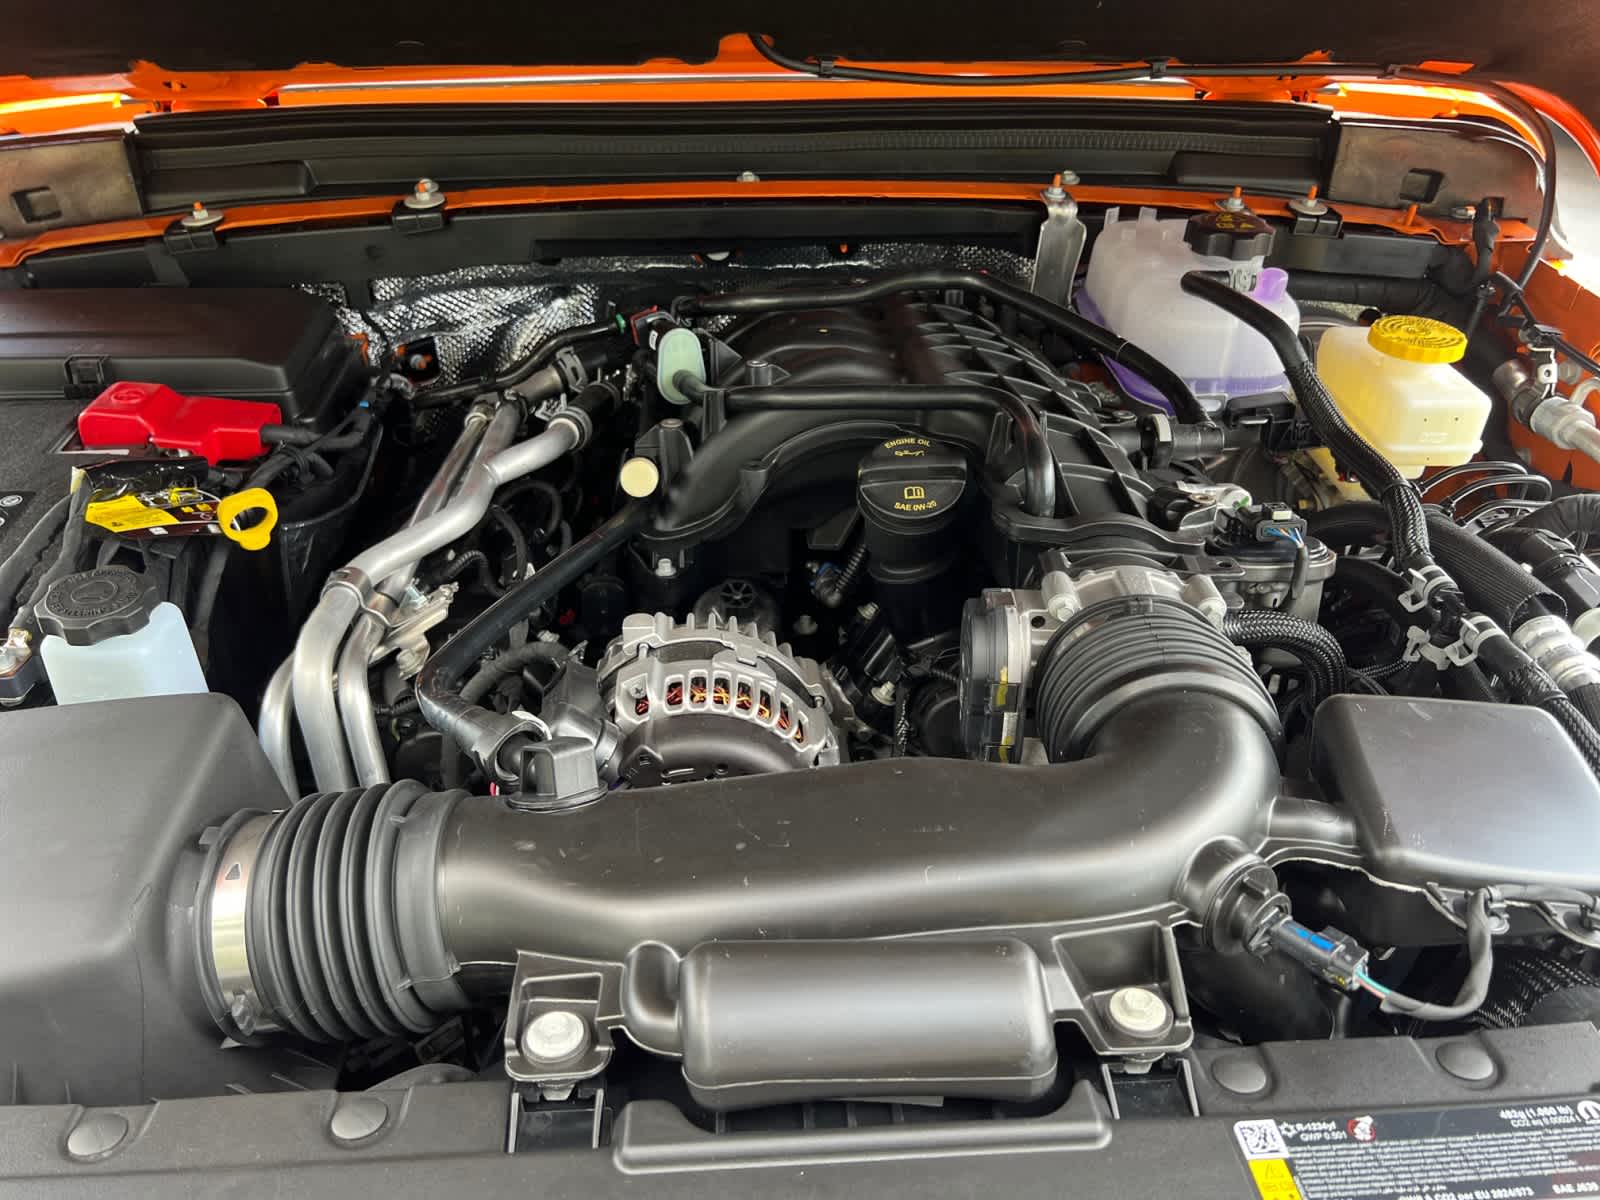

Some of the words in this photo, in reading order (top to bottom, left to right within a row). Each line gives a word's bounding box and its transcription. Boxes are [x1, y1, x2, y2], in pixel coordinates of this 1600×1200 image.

[884, 438, 915, 449] ENGINE
[918, 438, 930, 447] OIL
[894, 501, 911, 511] SAE
[913, 500, 937, 511] 0W-20
[1295, 1121, 1336, 1132] R-1234yf
[1300, 1132, 1322, 1141] GWP
[1474, 1189, 1491, 1200] EU
[1552, 1184, 1575, 1194] SAE
